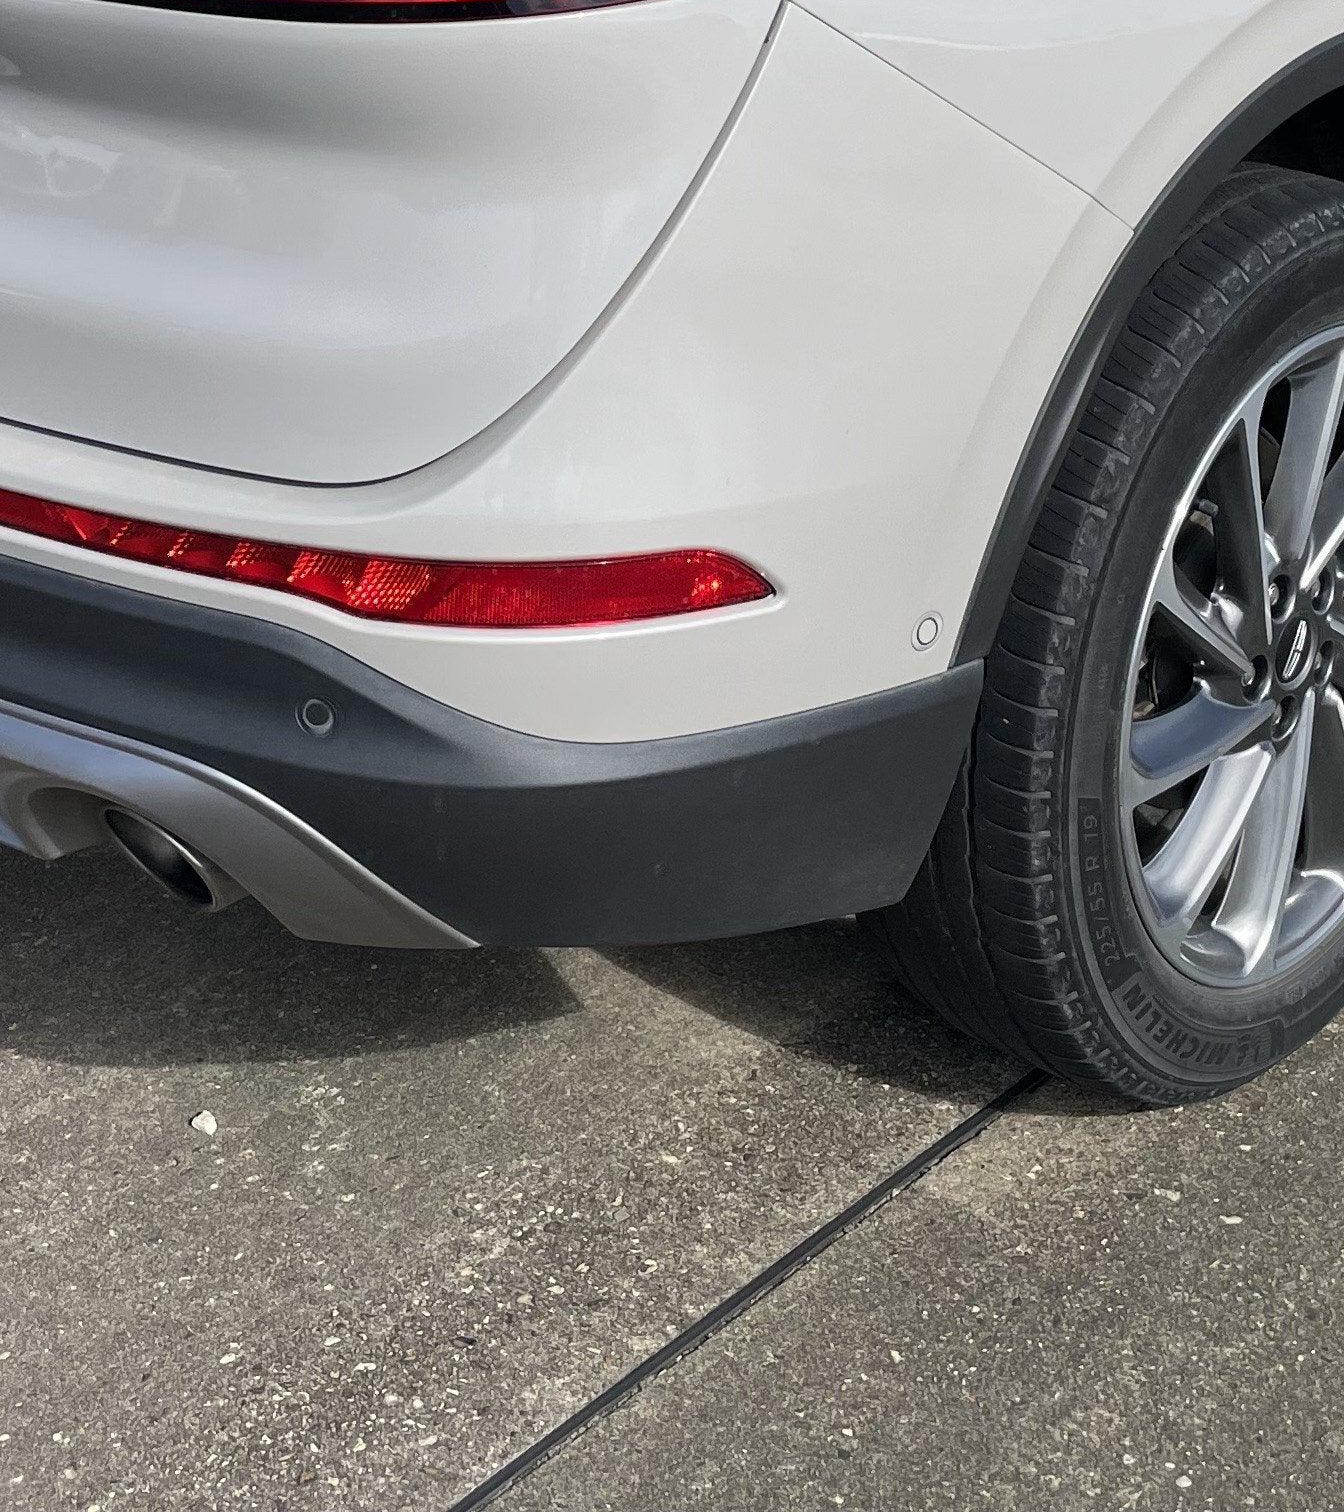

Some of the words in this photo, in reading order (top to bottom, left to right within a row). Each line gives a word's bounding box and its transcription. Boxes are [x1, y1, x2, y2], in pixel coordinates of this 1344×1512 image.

[1083, 814, 1099, 841] 19
[1084, 855, 1100, 872] R
[1088, 881, 1121, 967] 225/55
[1122, 983, 1231, 1066] MICHELIN
